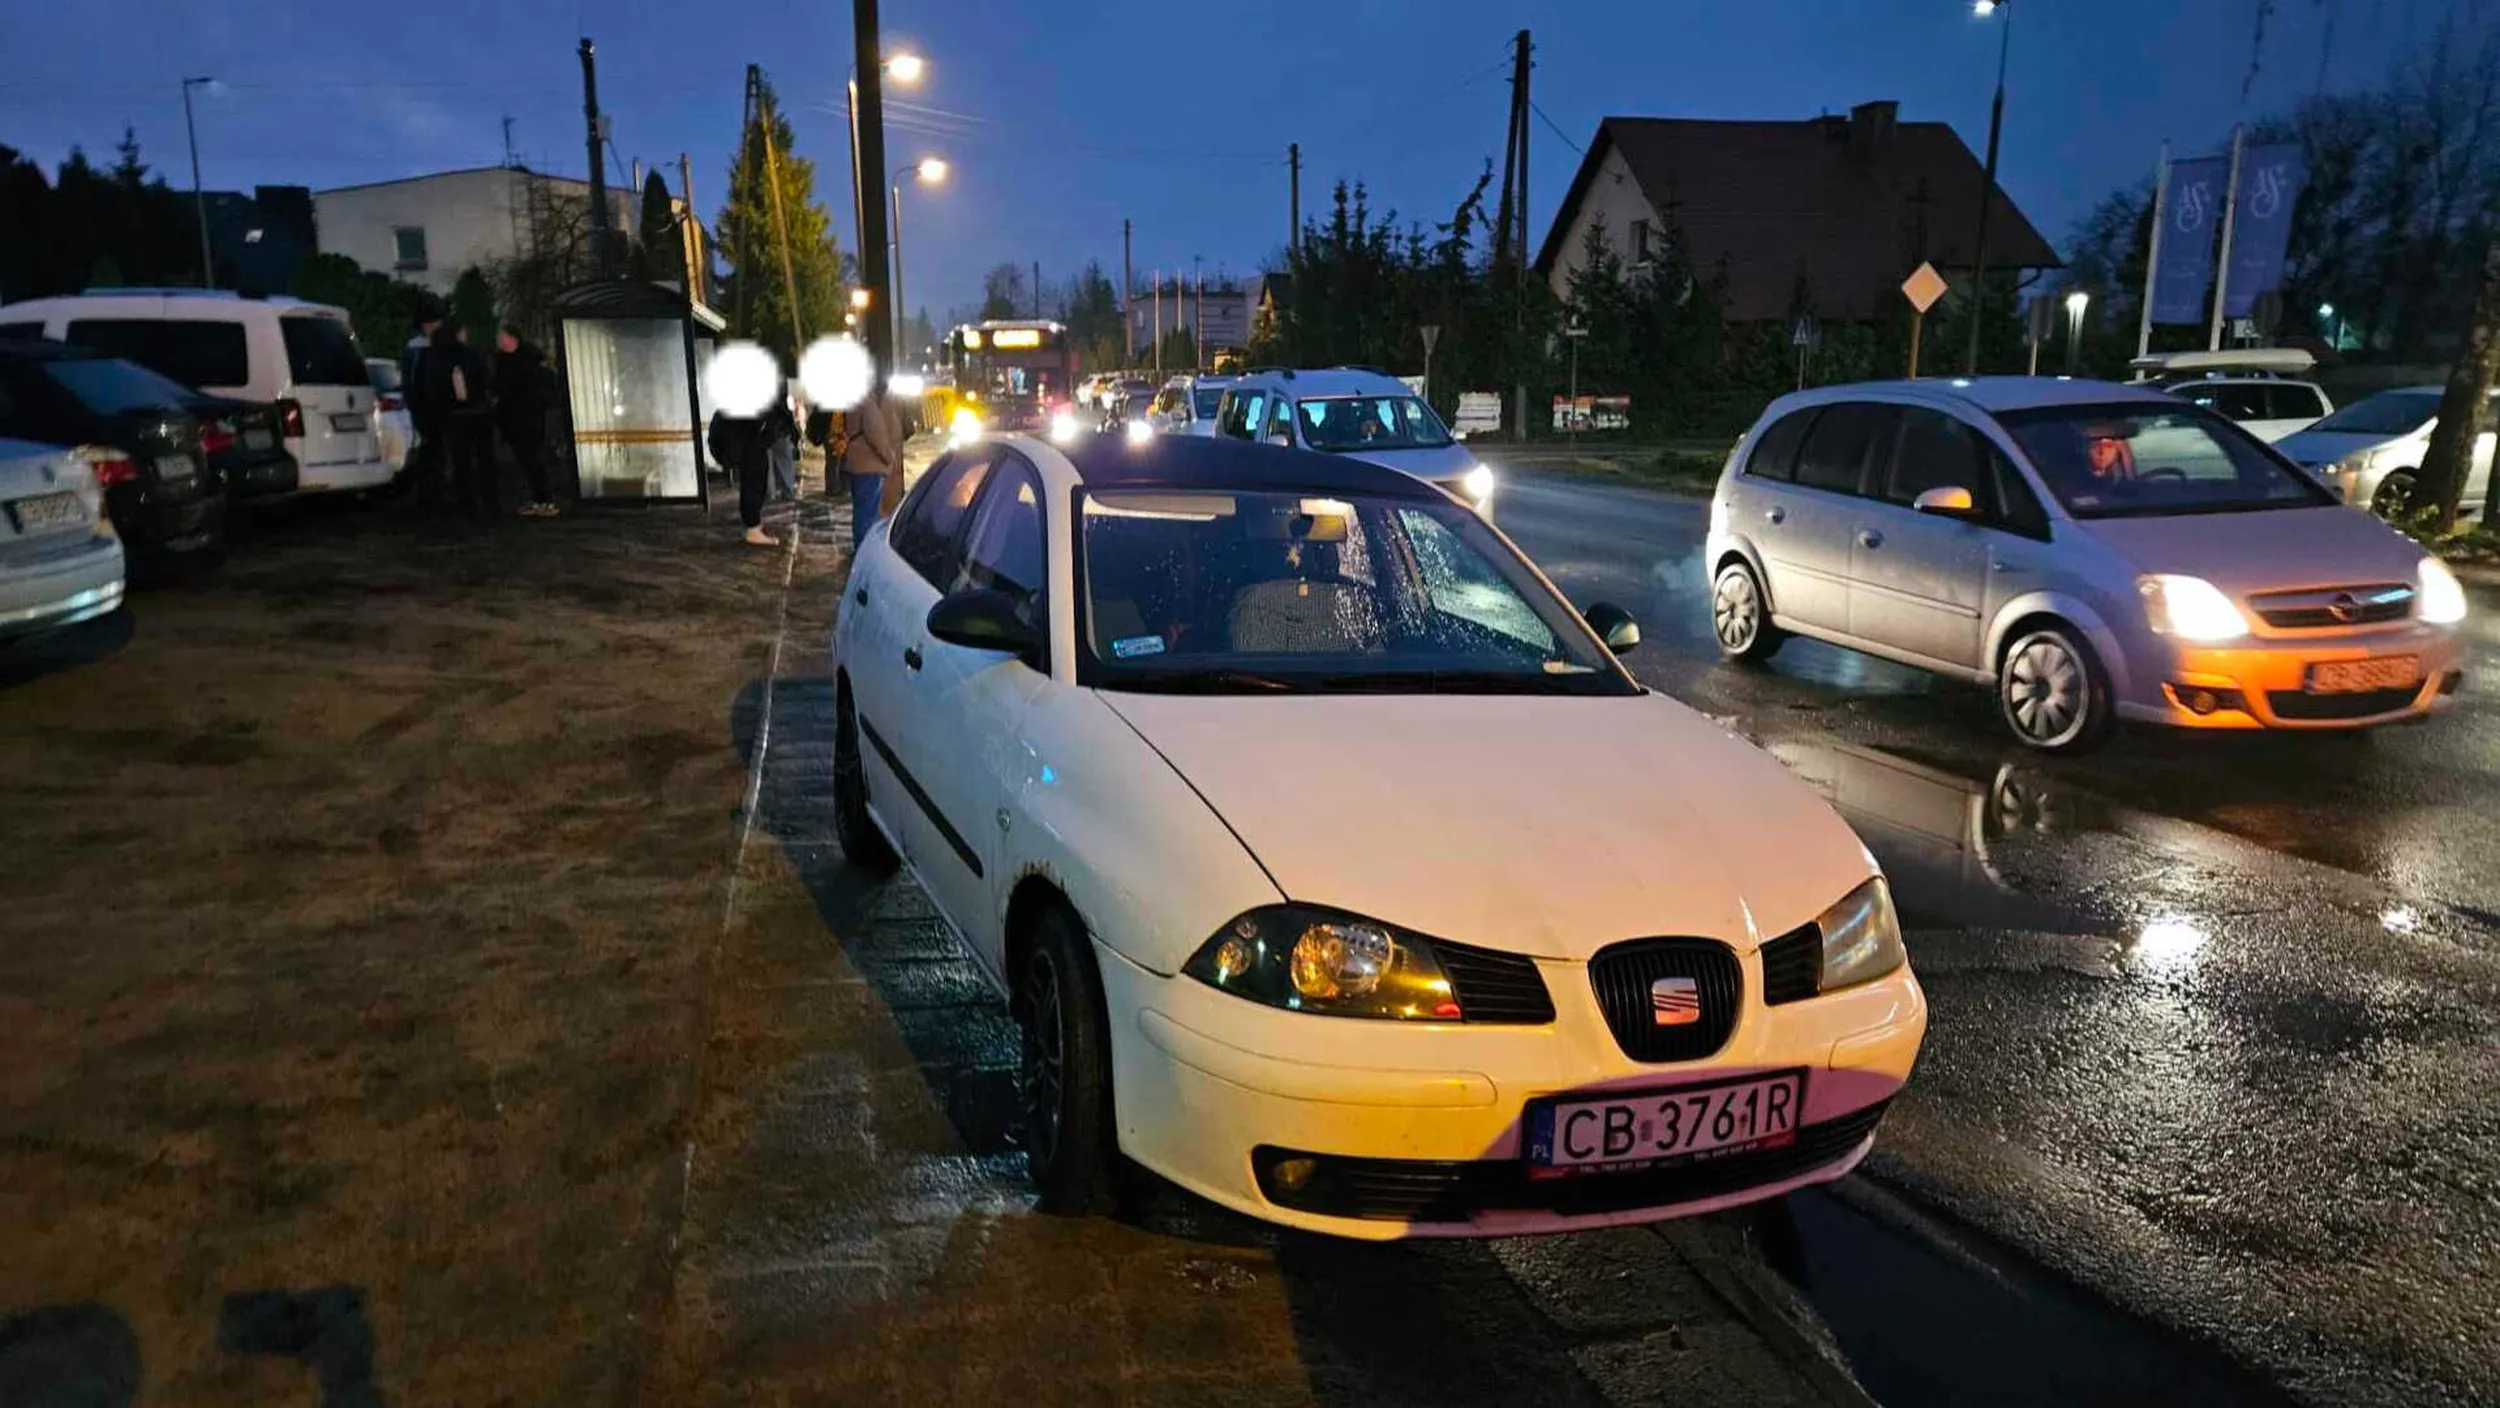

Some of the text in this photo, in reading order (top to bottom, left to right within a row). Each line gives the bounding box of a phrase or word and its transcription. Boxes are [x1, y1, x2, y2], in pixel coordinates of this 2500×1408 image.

[1562, 1082, 1793, 1160] CB 3761R
[1532, 1144, 1550, 1159] PL
